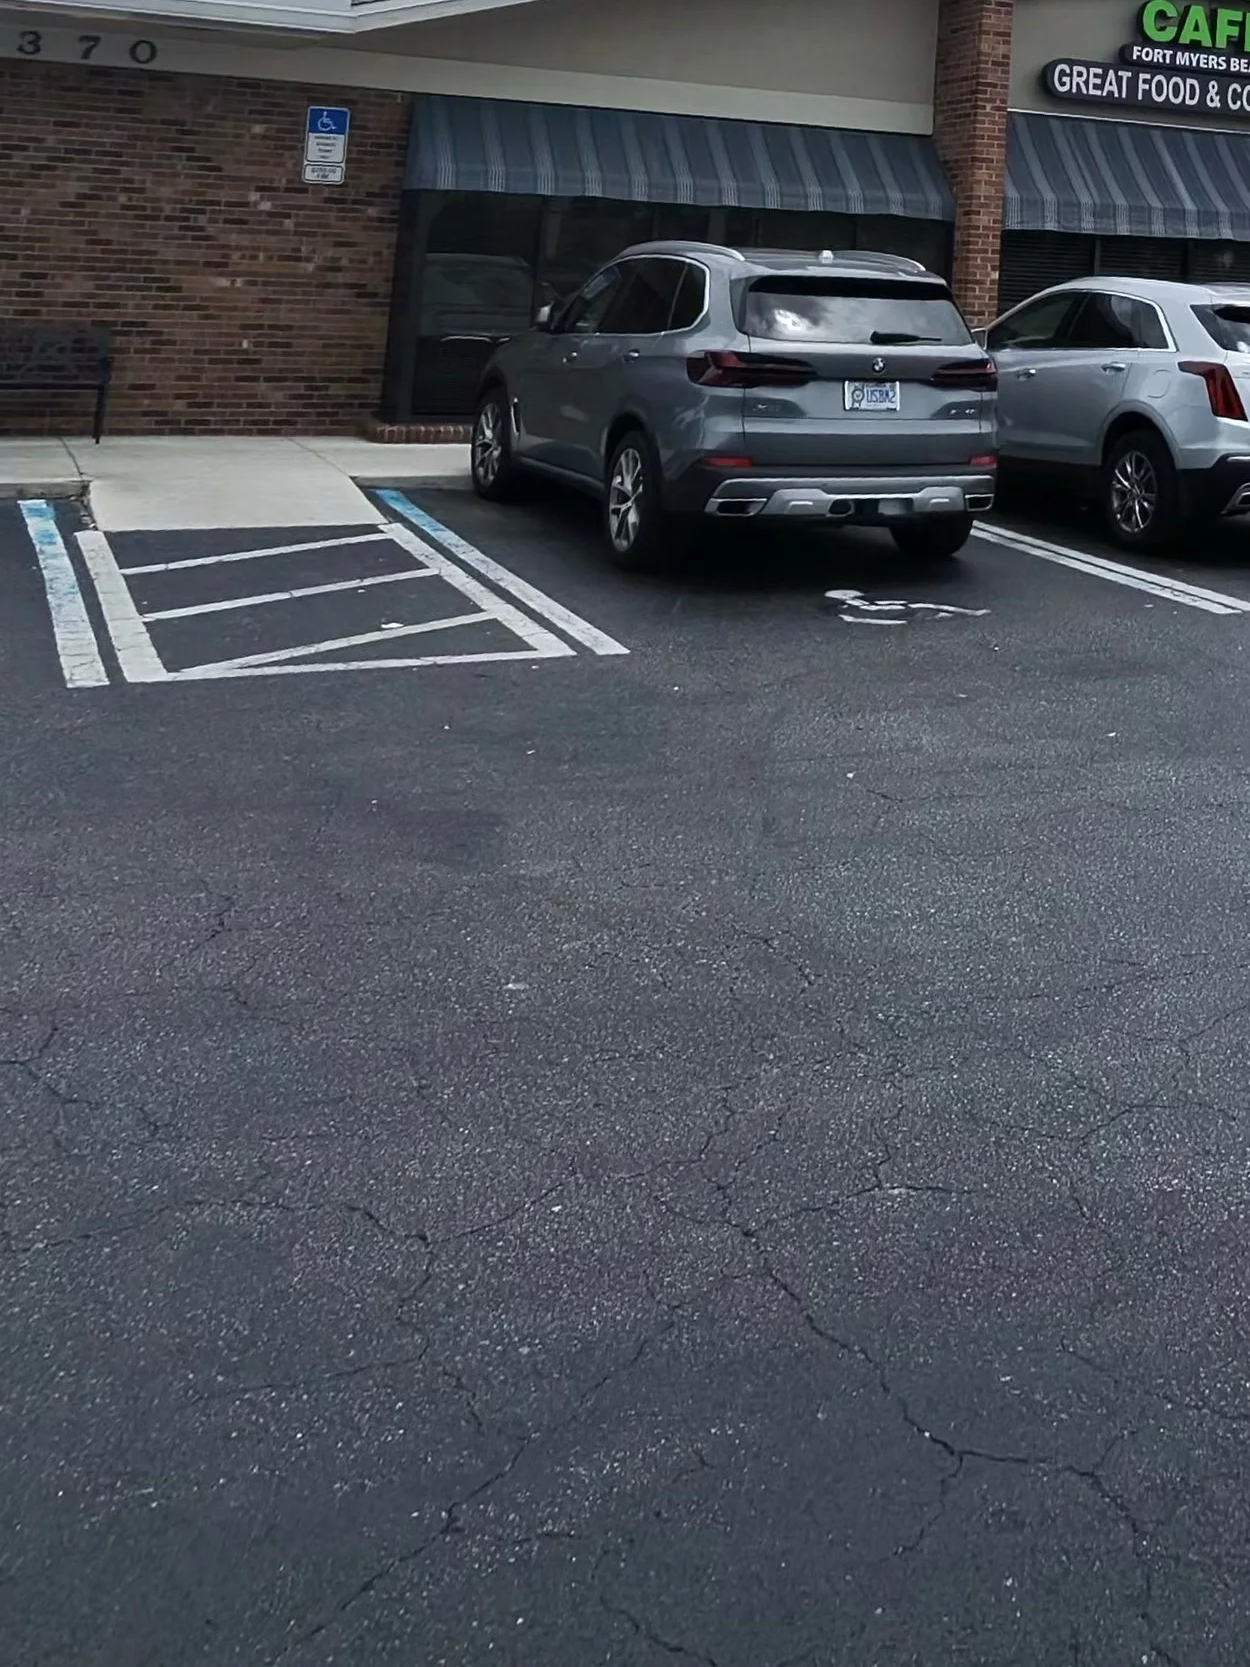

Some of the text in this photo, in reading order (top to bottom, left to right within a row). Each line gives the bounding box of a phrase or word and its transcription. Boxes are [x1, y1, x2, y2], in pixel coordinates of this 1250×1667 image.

[1132, 45, 1173, 64] FORT
[1176, 51, 1226, 70] MYERS
[1053, 63, 1132, 99] GREAT
[1137, 72, 1200, 106] FOOD
[1206, 80, 1221, 108] &
